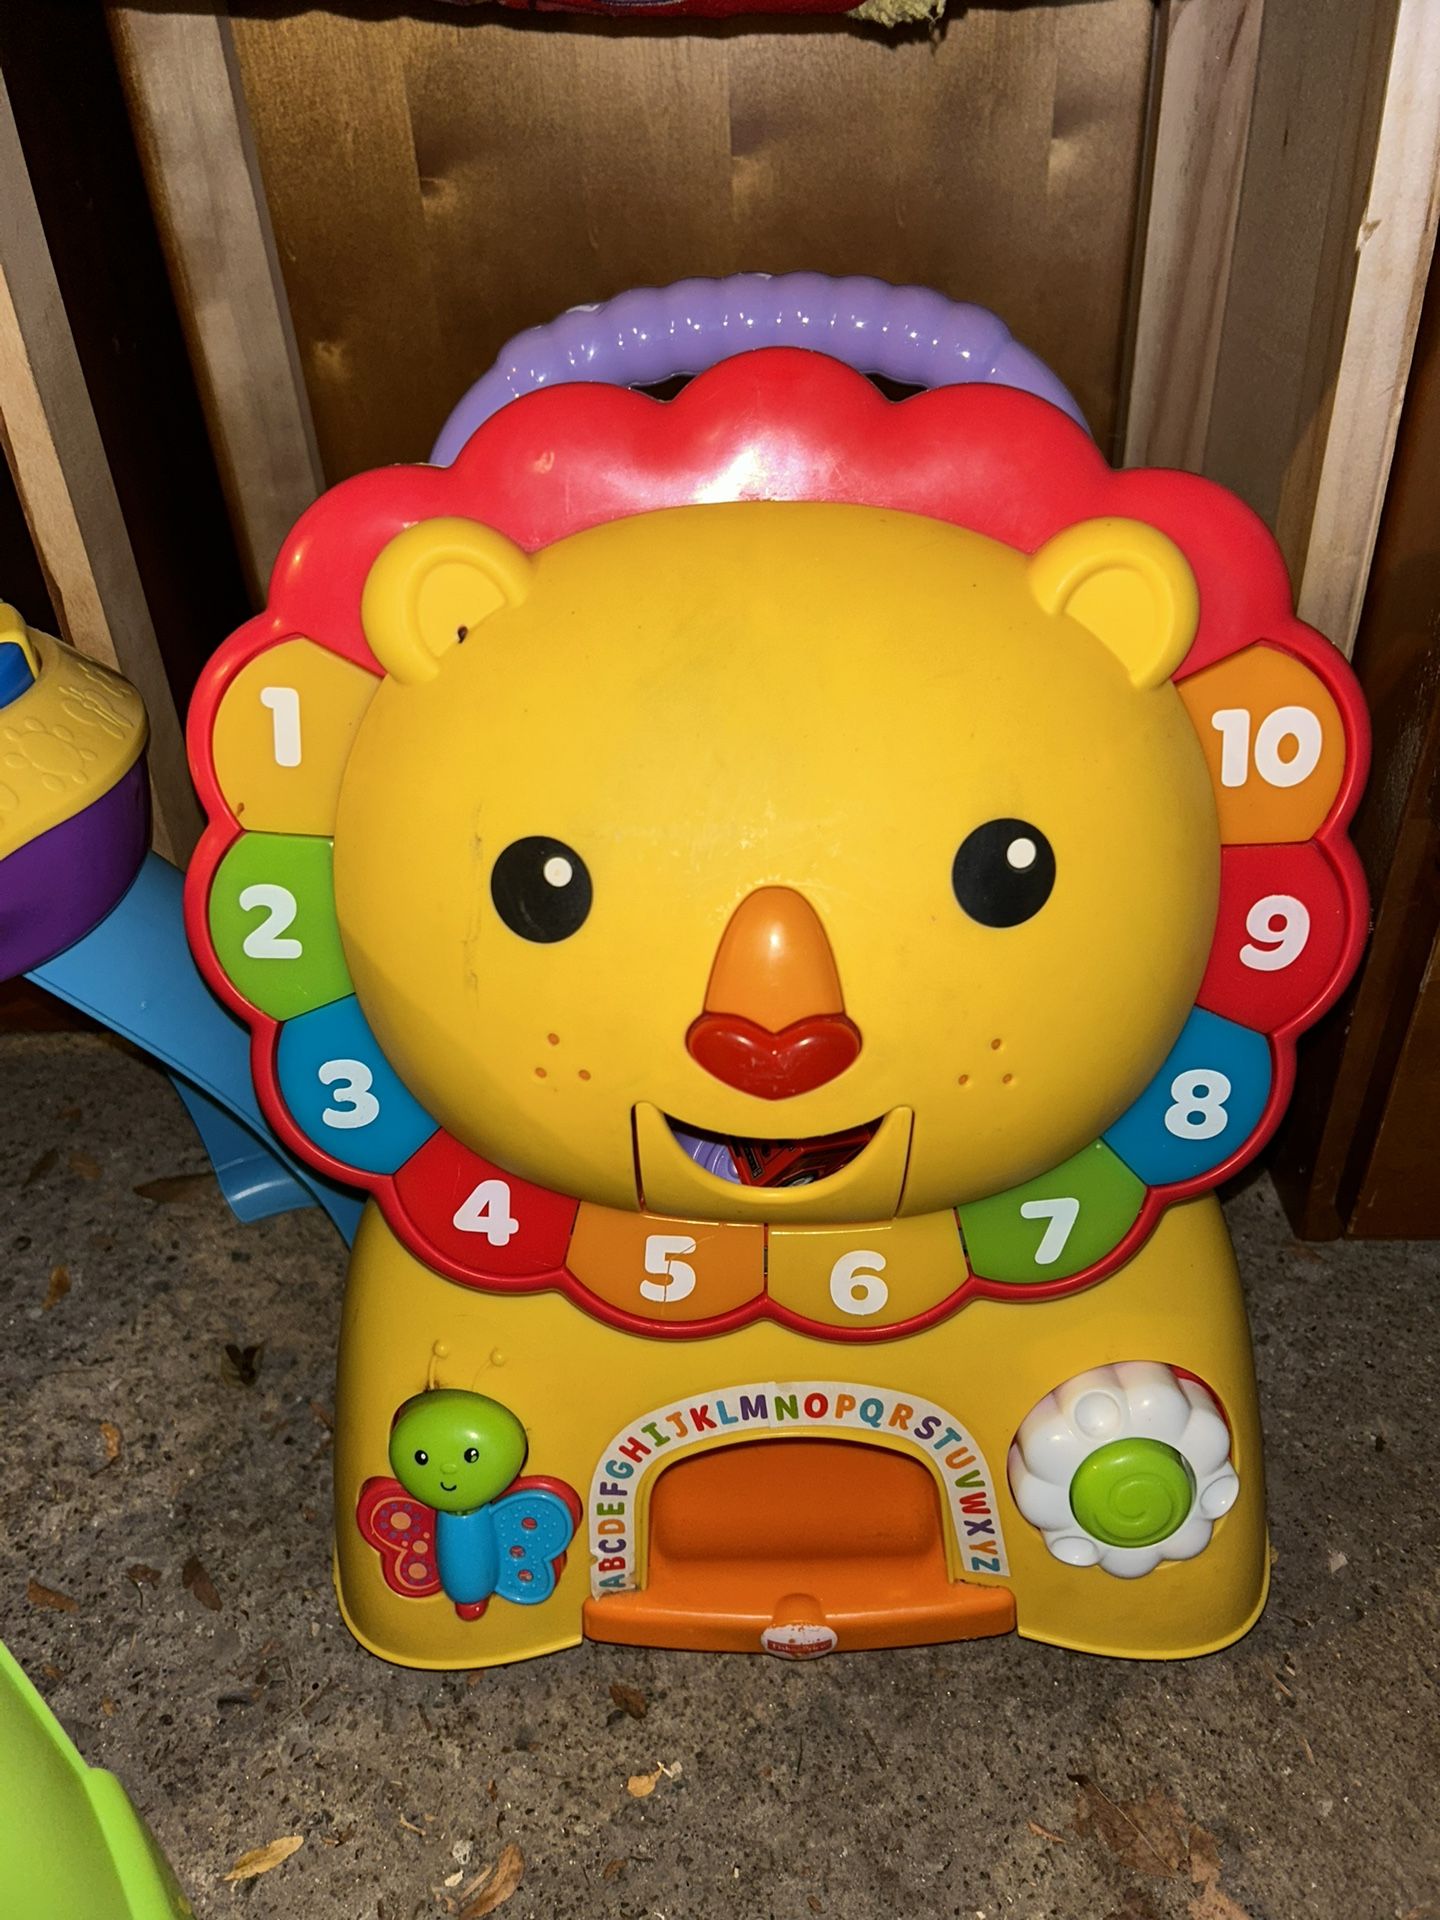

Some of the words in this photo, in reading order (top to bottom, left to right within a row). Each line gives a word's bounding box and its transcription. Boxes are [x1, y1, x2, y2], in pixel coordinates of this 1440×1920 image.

[261, 686, 301, 765] 1
[1212, 706, 1322, 787] 10
[239, 884, 302, 959] 2
[1240, 895, 1310, 971] 9
[318, 1059, 379, 1129] 3
[1164, 1069, 1231, 1140] 8
[453, 1180, 519, 1246] 4
[1021, 1197, 1080, 1265] 7
[641, 1235, 695, 1302] 5
[830, 1250, 888, 1315] 6
